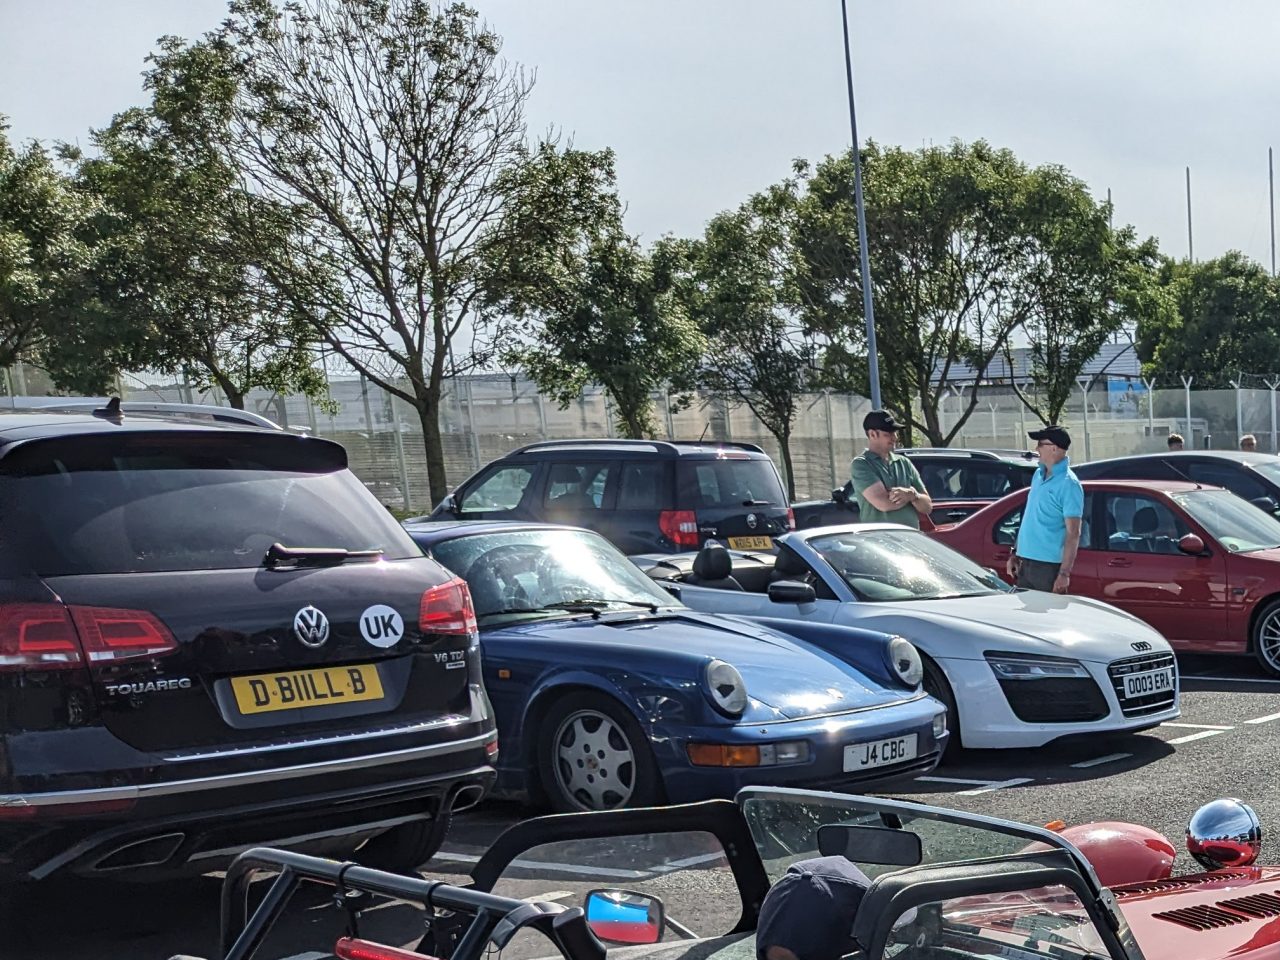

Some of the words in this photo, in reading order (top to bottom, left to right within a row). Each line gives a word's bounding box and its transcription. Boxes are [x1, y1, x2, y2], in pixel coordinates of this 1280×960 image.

[364, 614, 396, 640] UK
[434, 652, 448, 663] V6
[105, 678, 192, 697] TOUAREG
[1154, 671, 1171, 690] ERA
[249, 678, 272, 708] D
[860, 744, 878, 766] J4
[881, 739, 905, 762] CBG
